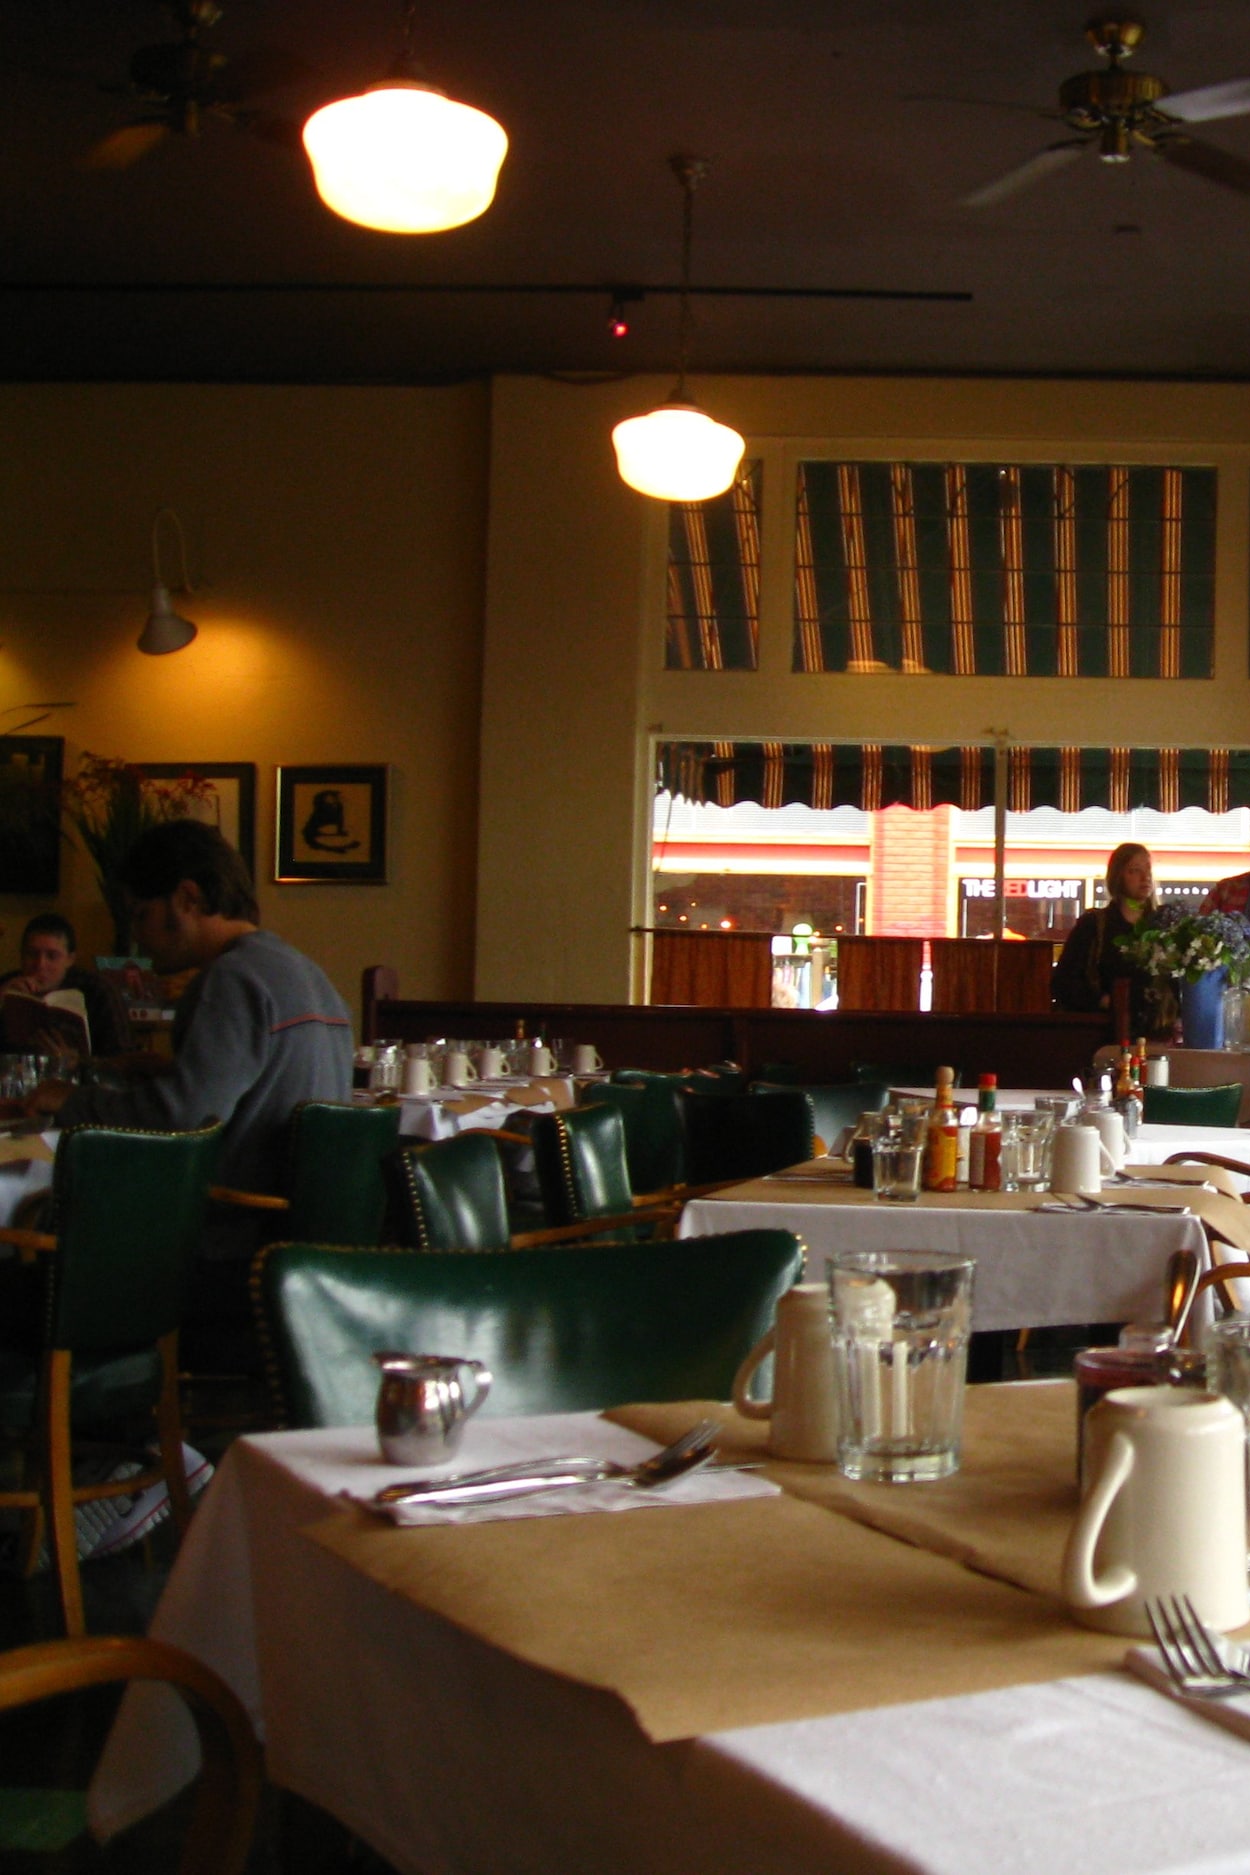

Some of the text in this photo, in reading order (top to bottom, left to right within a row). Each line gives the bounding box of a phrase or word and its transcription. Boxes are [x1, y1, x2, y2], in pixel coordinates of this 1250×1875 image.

[962, 879, 1082, 898] THE ED LIGHT
